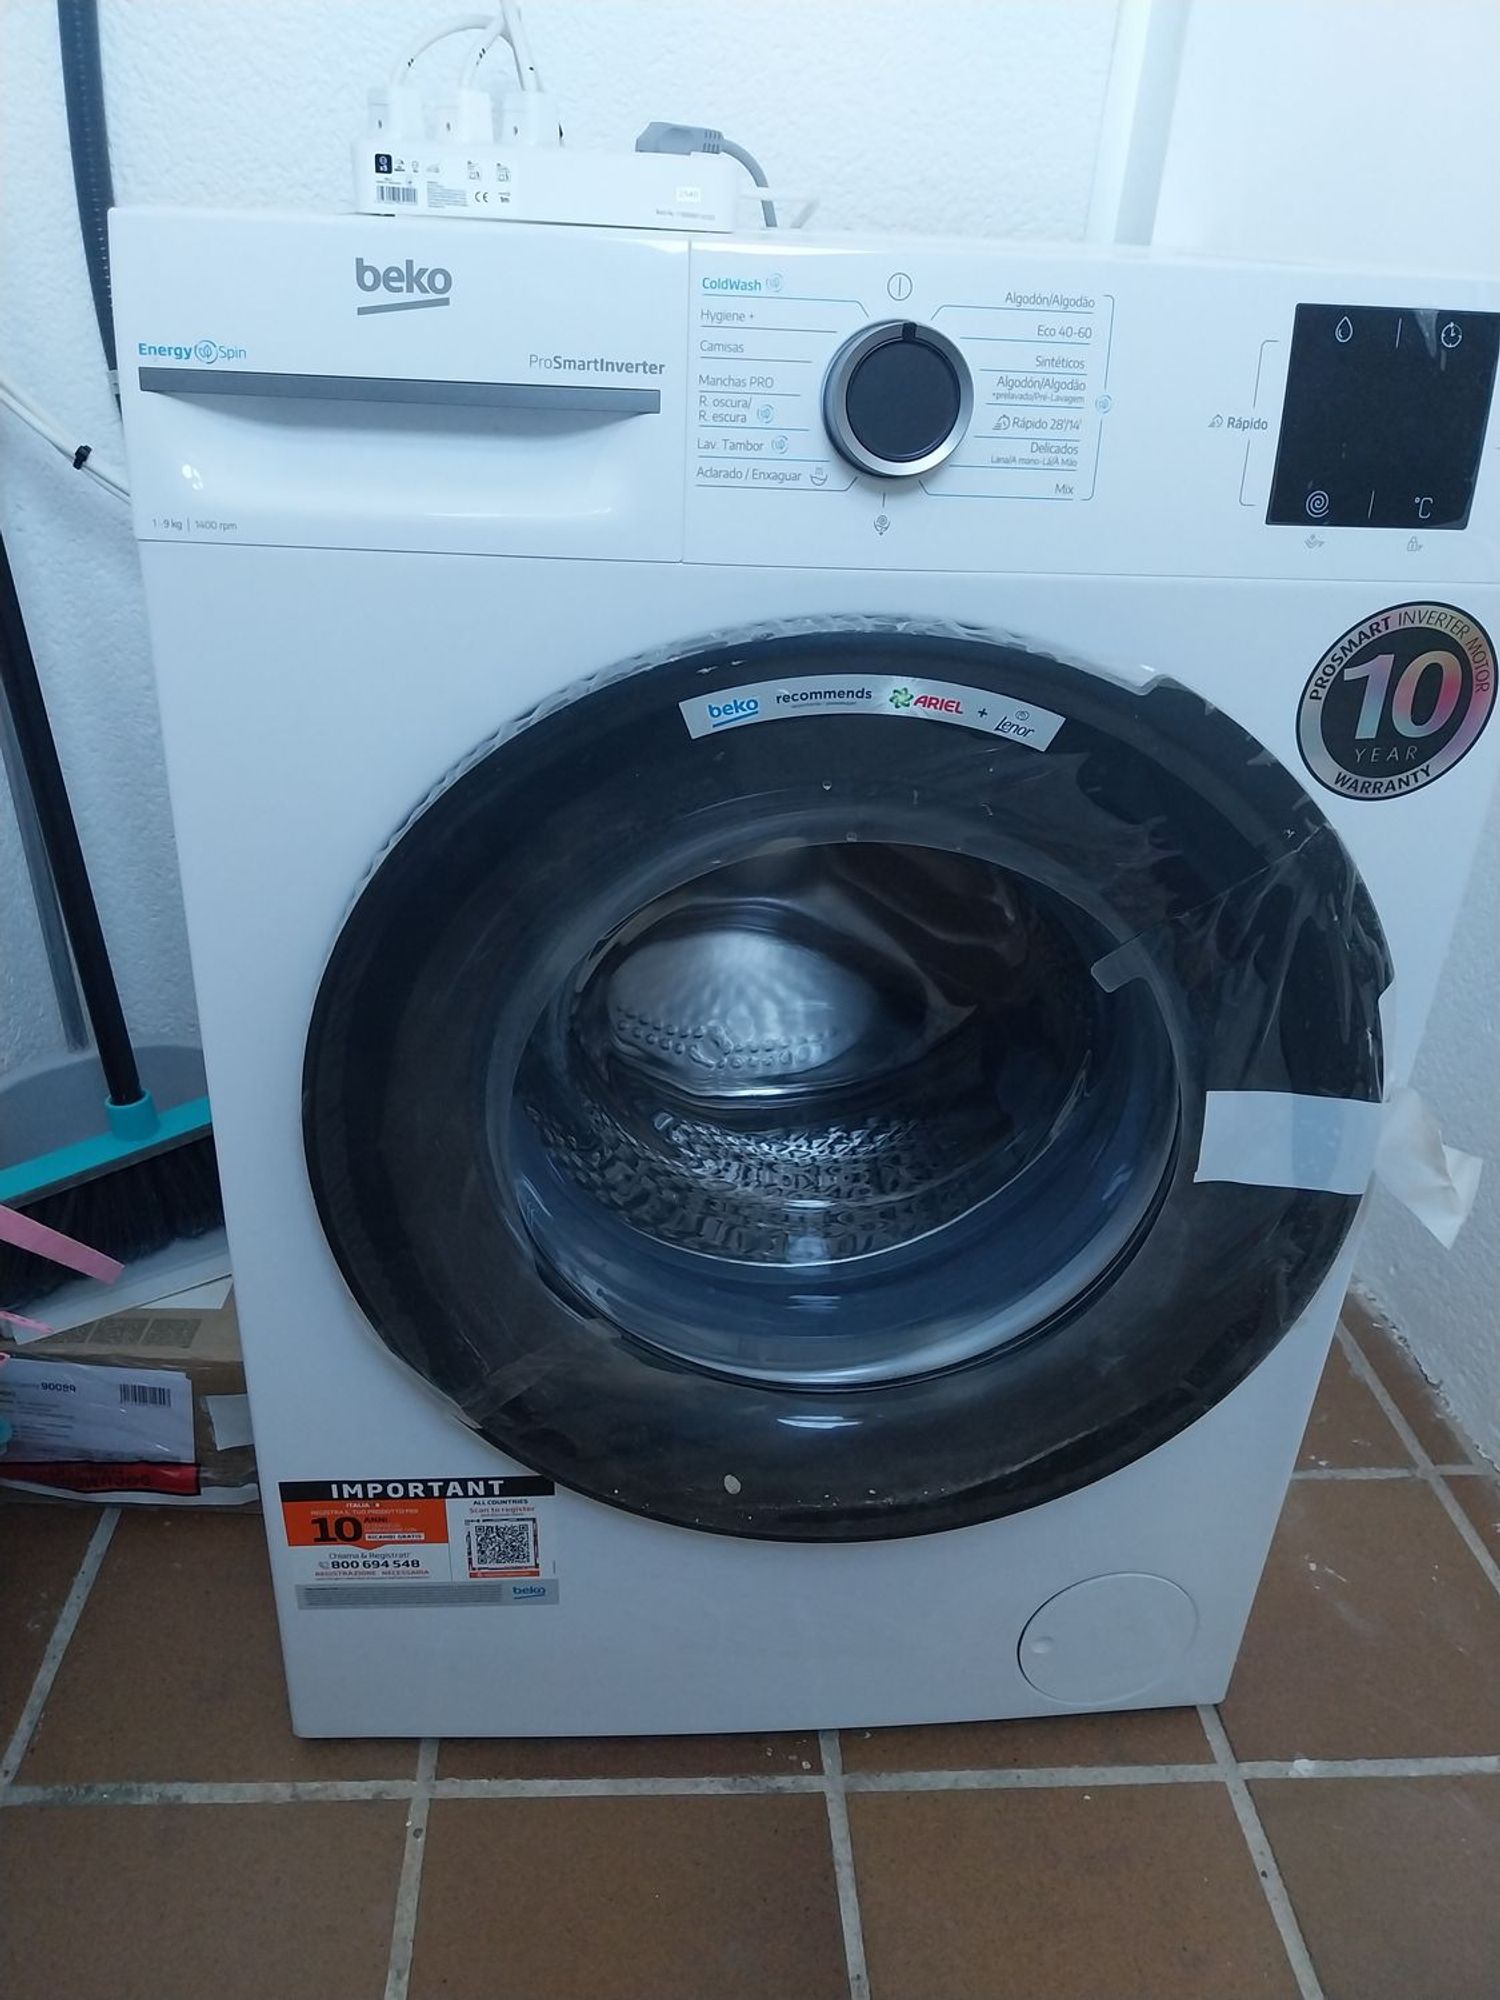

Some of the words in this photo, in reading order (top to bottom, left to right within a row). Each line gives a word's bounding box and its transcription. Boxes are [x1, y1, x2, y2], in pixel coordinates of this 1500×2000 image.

[355, 257, 453, 296] beko
[701, 277, 762, 292] ColdWash
[700, 309, 746, 322] Hygiene
[1037, 324, 1056, 337] Eco
[1058, 325, 1092, 339] 40-60
[138, 342, 193, 360] Energy
[218, 345, 247, 361] Spin
[700, 340, 744, 353] Camisas
[528, 353, 666, 376] ProSmartInverter
[1035, 354, 1085, 369] Sintéticos
[699, 374, 747, 388] Manchas
[749, 376, 774, 388] PRO
[713, 412, 747, 423] escura
[1011, 416, 1048, 431] Rápido
[1226, 416, 1269, 431] Rápido
[723, 438, 764, 452] Tambor
[1030, 441, 1079, 455] Delicados
[696, 467, 743, 480] Aclarado
[752, 468, 802, 484] Enxaguar
[1054, 483, 1074, 494] Mix
[220, 522, 238, 533] rpm
[1309, 616, 1392, 701] PROSMART
[1398, 609, 1470, 640] INVERTER
[1465, 636, 1491, 694] MOTOR
[1343, 650, 1463, 740] 10
[708, 698, 759, 719] beko
[776, 688, 872, 704] recommends
[913, 695, 964, 715] ARIEL
[994, 716, 1035, 738] Lenor
[1355, 745, 1418, 763] YEAR
[1334, 764, 1432, 795] WARRANTY
[331, 1480, 504, 1499] IMPORTANT
[311, 1516, 363, 1542] 10
[331, 1560, 359, 1569] 800
[362, 1560, 390, 1569] 694
[392, 1559, 420, 1568] 548
